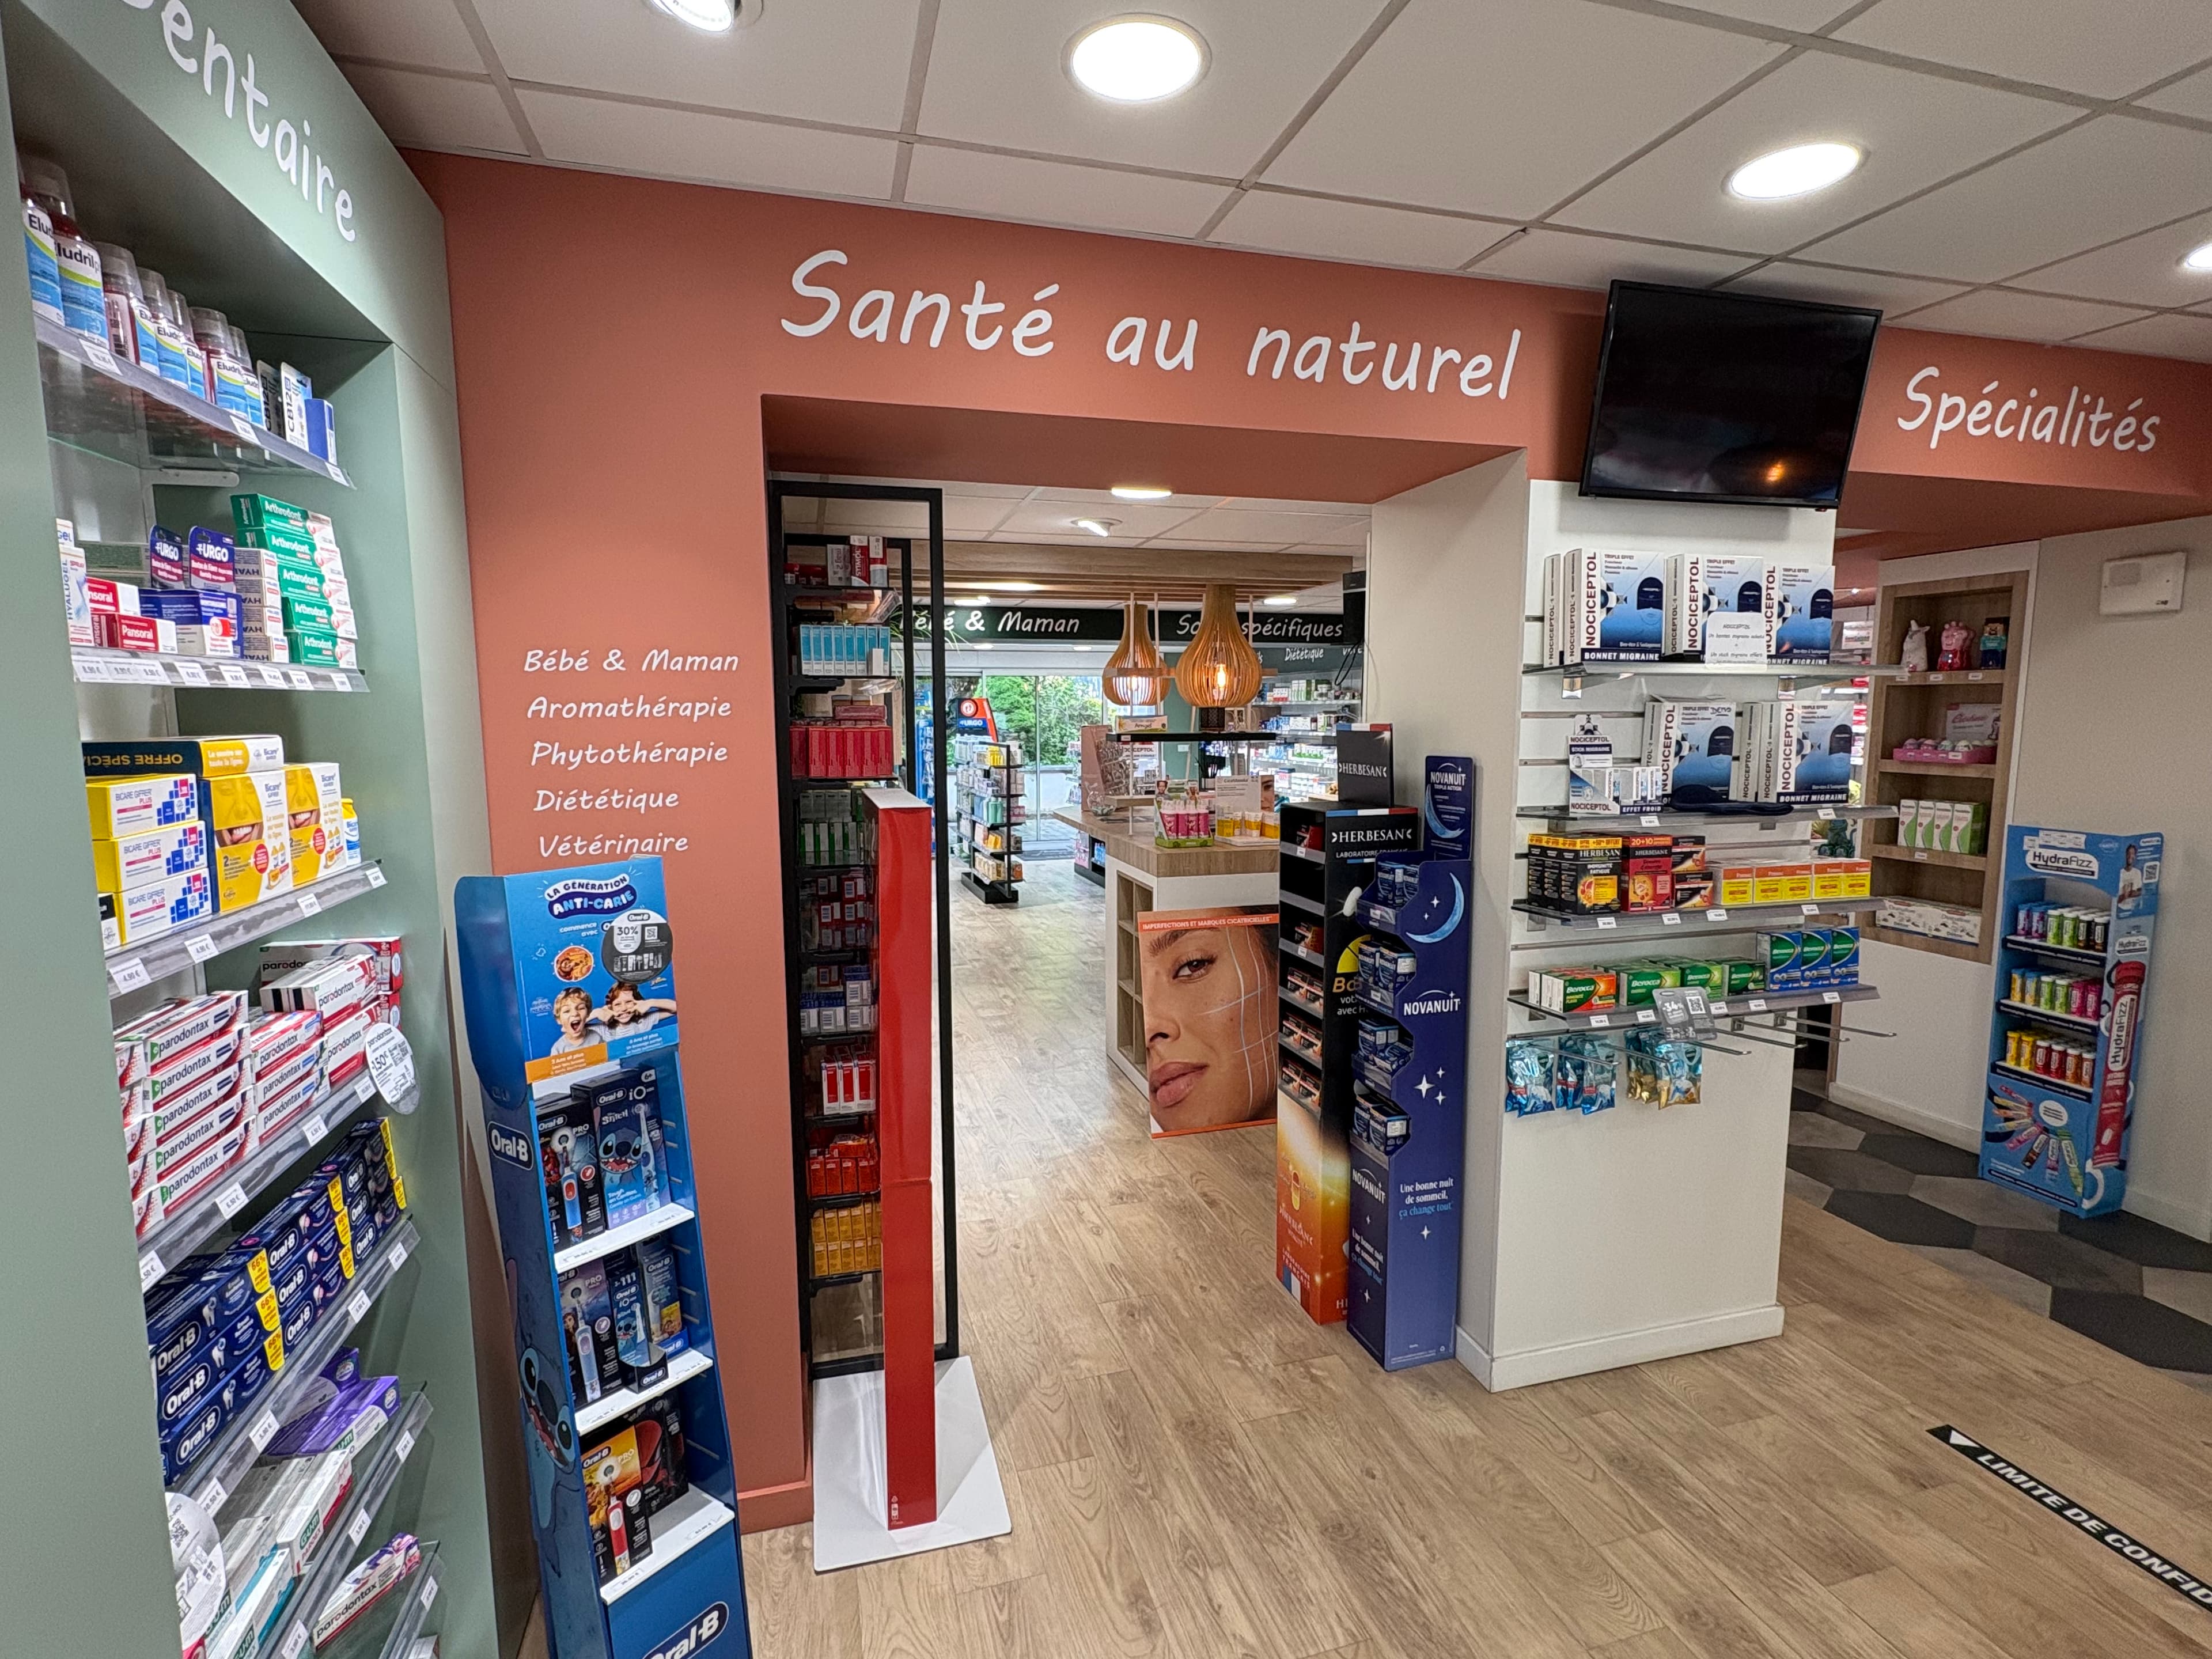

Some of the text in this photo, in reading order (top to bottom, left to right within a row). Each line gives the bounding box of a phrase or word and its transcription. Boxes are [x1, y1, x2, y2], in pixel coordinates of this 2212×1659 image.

[123, 0, 356, 242] entaire
[781, 249, 1521, 399] Santé au naturel
[1897, 366, 2160, 452] Spécialités
[264, 501, 302, 520] Arthrodent
[160, 543, 179, 560] URGO
[203, 544, 228, 562] URGO
[271, 535, 310, 554] Arthrodent
[283, 569, 319, 586] Arthrodent
[87, 590, 113, 603] nsoral
[1586, 551, 1596, 646] NOCICEPTOL
[1688, 556, 1699, 649] NOCICEPTOL
[295, 602, 328, 617] Arthrodent
[1764, 566, 1775, 653] NOCICEPTOL
[122, 624, 153, 639] Pansoral
[965, 610, 986, 631] &
[998, 611, 1080, 633] Maman
[1241, 617, 1343, 641] spécifiques
[524, 649, 738, 671] Bébé & Maman
[1285, 646, 1324, 662] Diététique
[1584, 652, 1660, 661] BONNET MIGRAINE
[527, 695, 732, 722] Aromathérapie
[531, 741, 728, 771] Phytothérapie
[1662, 704, 1675, 792] NOCICEPTOL
[1782, 703, 1794, 791] NOCICEPTOL
[135, 754, 183, 765] OFFRE
[1342, 763, 1382, 778] HERBESAN
[1430, 771, 1467, 786] NOVANUIT
[116, 792, 134, 801] BICARE
[533, 788, 679, 815] Diététique
[1571, 802, 1612, 811] NOCICEPTOL
[539, 832, 689, 858] Vétérinaire
[1340, 830, 1404, 843] HERBESAN
[124, 843, 142, 854] BICARE
[1580, 849, 1620, 857] HERBESAN
[2033, 851, 2093, 868] HydraFizz
[546, 876, 627, 899] LA GÉNÉRATION
[128, 895, 146, 906] BICARE
[553, 890, 634, 915] ANTI-CARIE
[616, 926, 639, 935] 30%
[1142, 922, 1190, 930] IMPERFECTIONS
[263, 960, 308, 972] parodo
[319, 980, 355, 1007] parodontax
[1566, 983, 1594, 994] Berocca
[1631, 979, 1661, 987] Berocca
[1337, 1007, 1355, 1015] avec
[1404, 998, 1460, 1016] NOVANUIT
[158, 1018, 209, 1058] parodontax
[2111, 1001, 2128, 1065] HydraFizz
[260, 1033, 298, 1066] parodontax
[328, 1029, 362, 1060] parodontax
[161, 1054, 211, 1095] parodontax
[263, 1062, 301, 1099] parodontax
[599, 1089, 624, 1104] Oral-B
[162, 1088, 213, 1130] parodontax
[263, 1092, 302, 1129] parodontax
[538, 1116, 565, 1131] Oral-B
[573, 1124, 589, 1135] PRO
[164, 1120, 214, 1166] parodontax
[491, 1128, 529, 1162] Oral-B
[168, 1151, 219, 1199] parodontax
[1400, 1177, 1454, 1193] Une bonne nuit
[1352, 1169, 1385, 1204] NOVANUIT
[1406, 1191, 1448, 1204] de sommeil,
[1399, 1202, 1452, 1220] ça change tout
[270, 1232, 296, 1266] Oral-B
[278, 1268, 305, 1303] Oral-B
[585, 1275, 603, 1287] PRO
[287, 1306, 312, 1341] Oral-B
[157, 1326, 196, 1372] Oral-B
[642, 1370, 663, 1384] Oral-B
[166, 1369, 206, 1415] Oral-B
[179, 1412, 217, 1459] Oral-B
[583, 1448, 609, 1468] Oral-B
[1977, 1454, 2069, 1508] LIMITE
[2062, 1506, 2108, 1534] DE
[316, 1581, 377, 1640] parodontax
